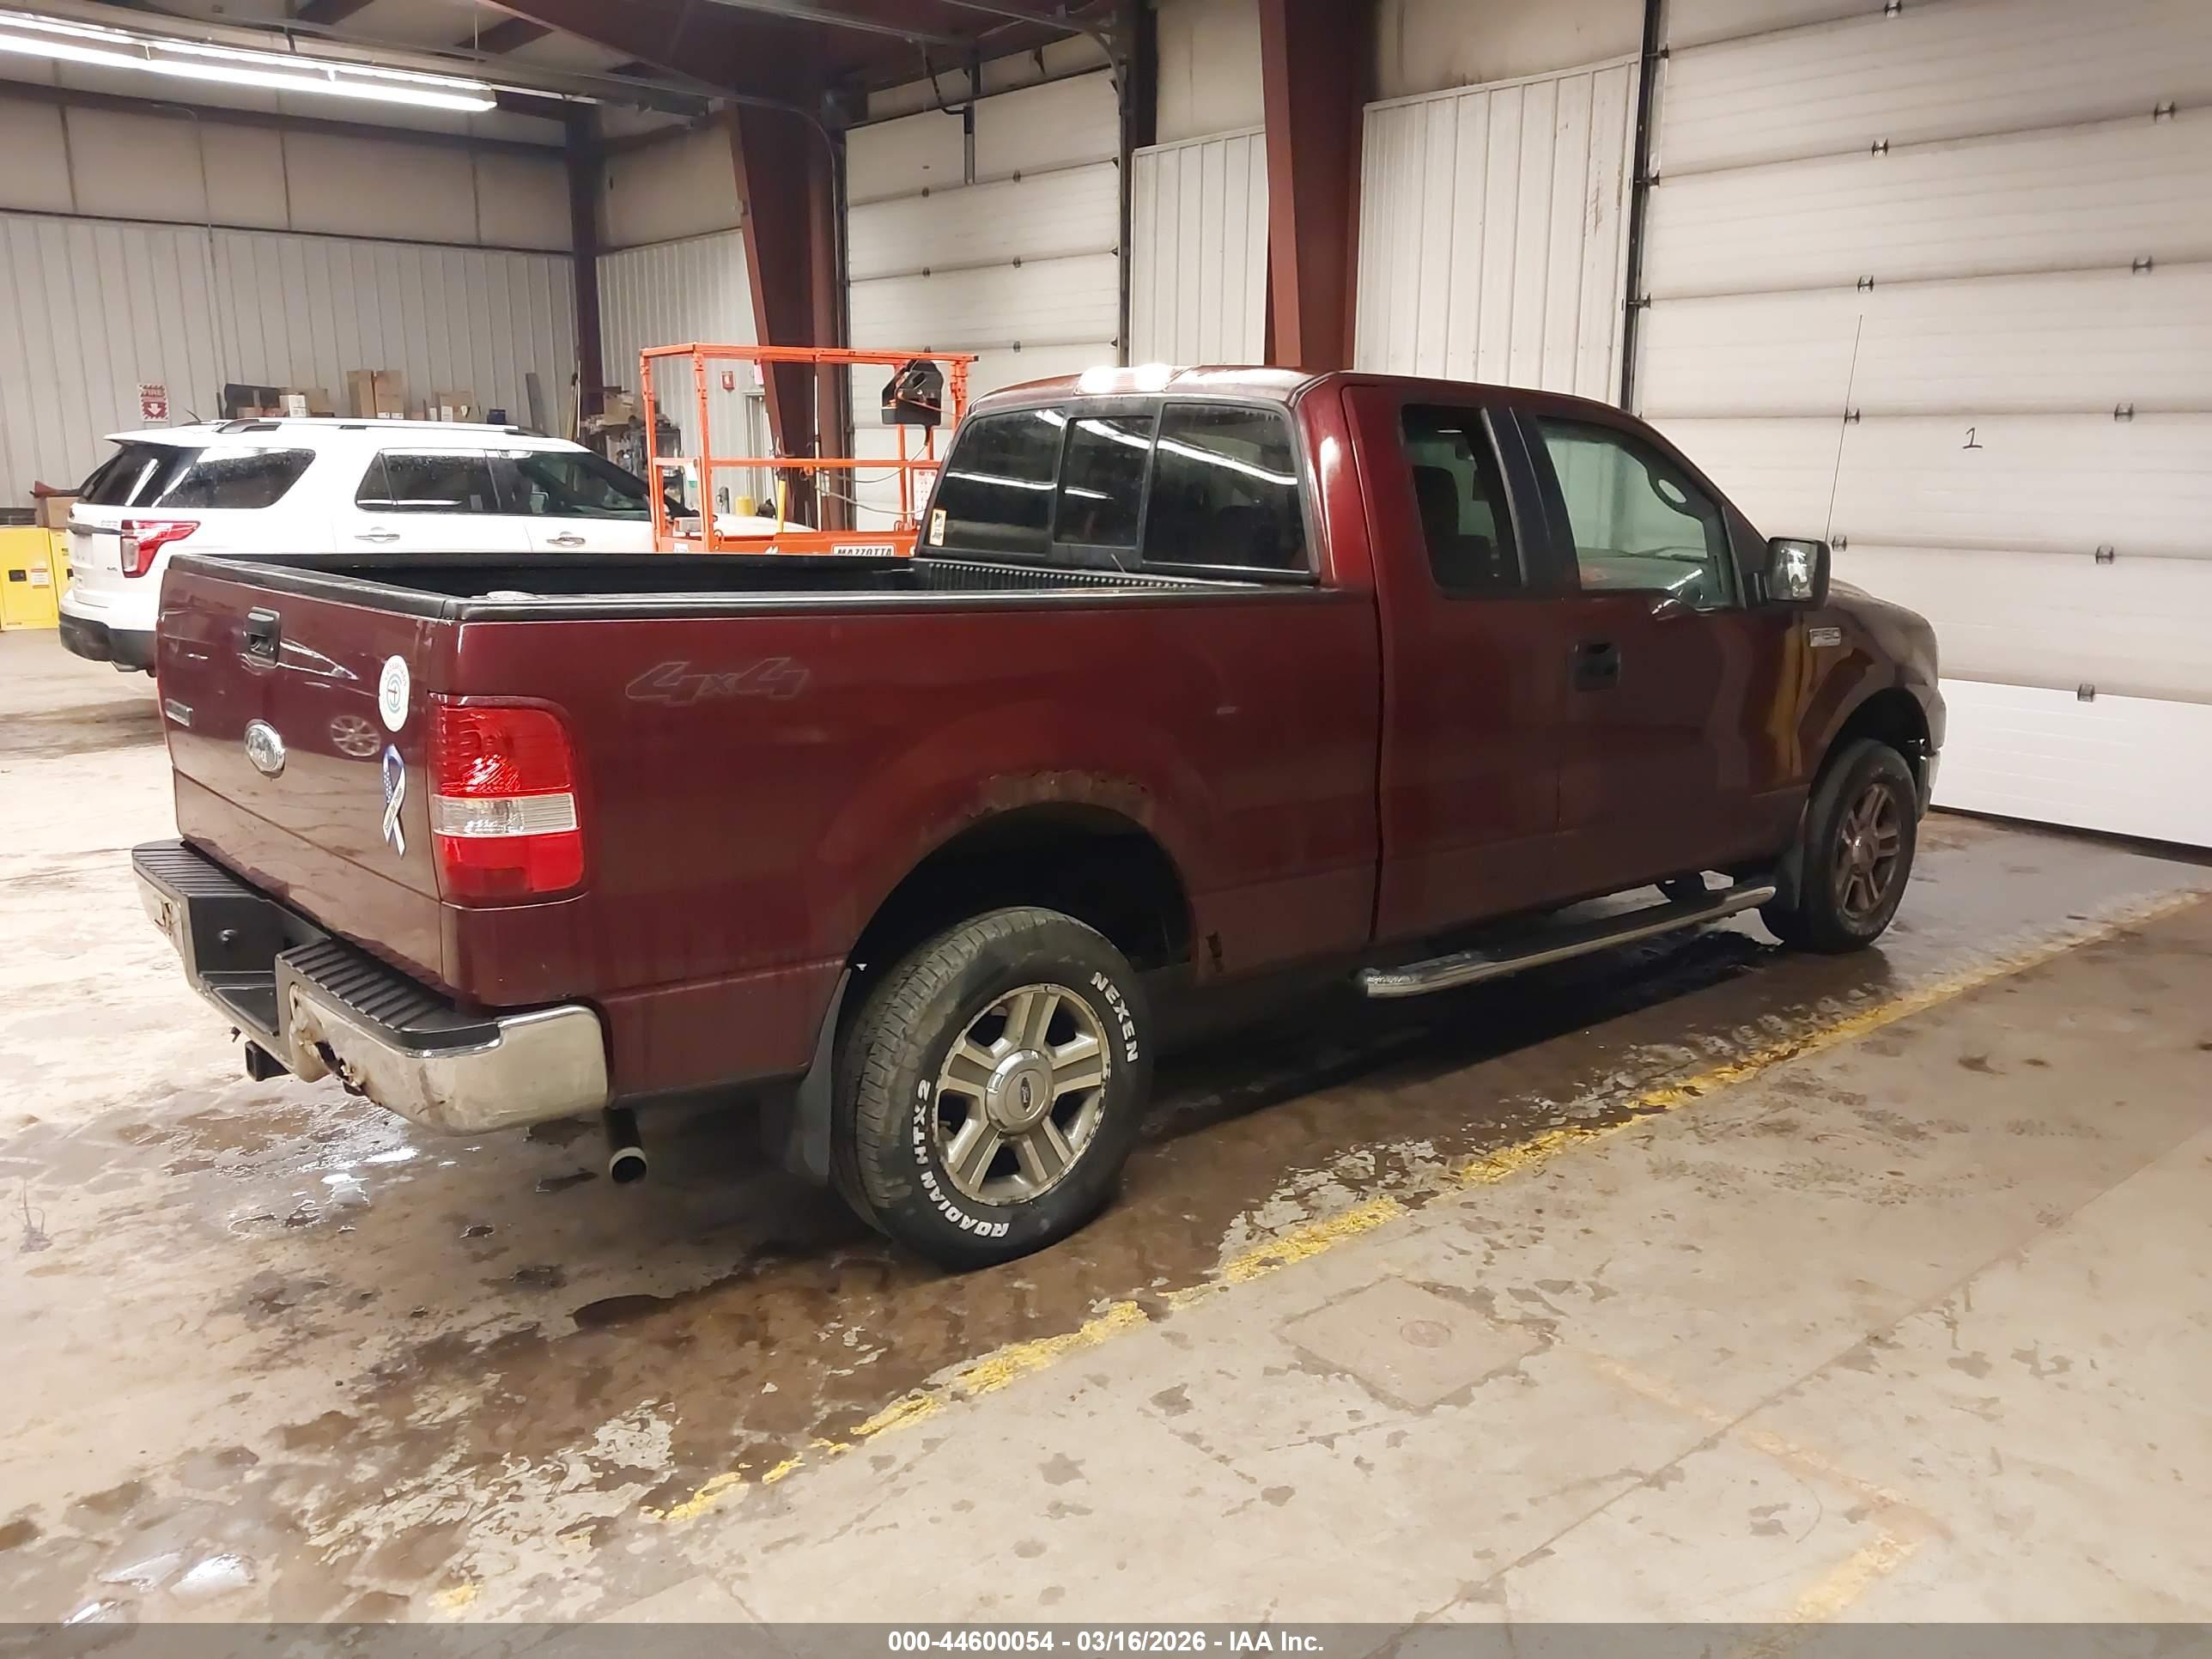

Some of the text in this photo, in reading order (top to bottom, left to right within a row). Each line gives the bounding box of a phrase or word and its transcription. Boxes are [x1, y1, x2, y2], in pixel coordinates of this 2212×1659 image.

[1963, 428, 1983, 449] 1
[625, 657, 810, 706] 4x4
[1090, 971, 1139, 1062] NEXEN
[921, 1170, 1011, 1237] ROADIAN
